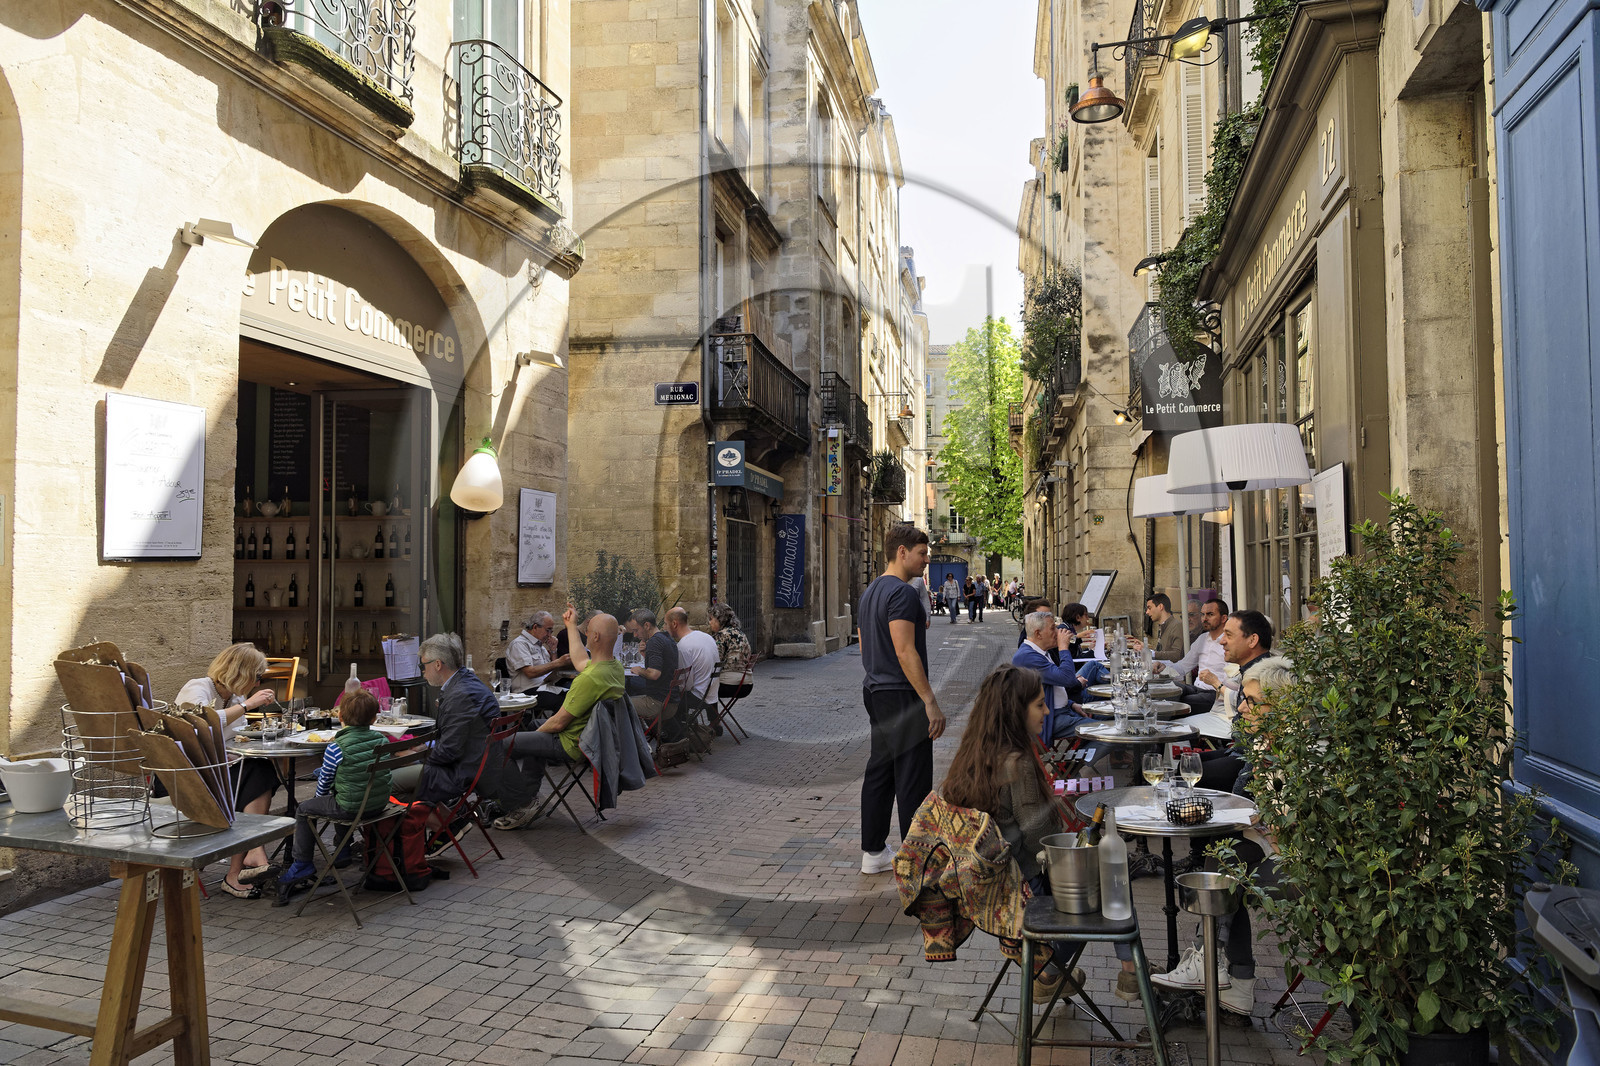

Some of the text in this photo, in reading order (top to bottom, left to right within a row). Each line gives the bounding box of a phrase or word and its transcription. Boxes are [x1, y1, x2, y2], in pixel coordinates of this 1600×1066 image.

[1321, 118, 1337, 187] 22
[1239, 189, 1308, 332] Le Petit Commerce
[242, 256, 455, 362] e Petit Commerce
[660, 393, 694, 401] MERIGNAC
[1145, 402, 1221, 414] Le Petit Commerce
